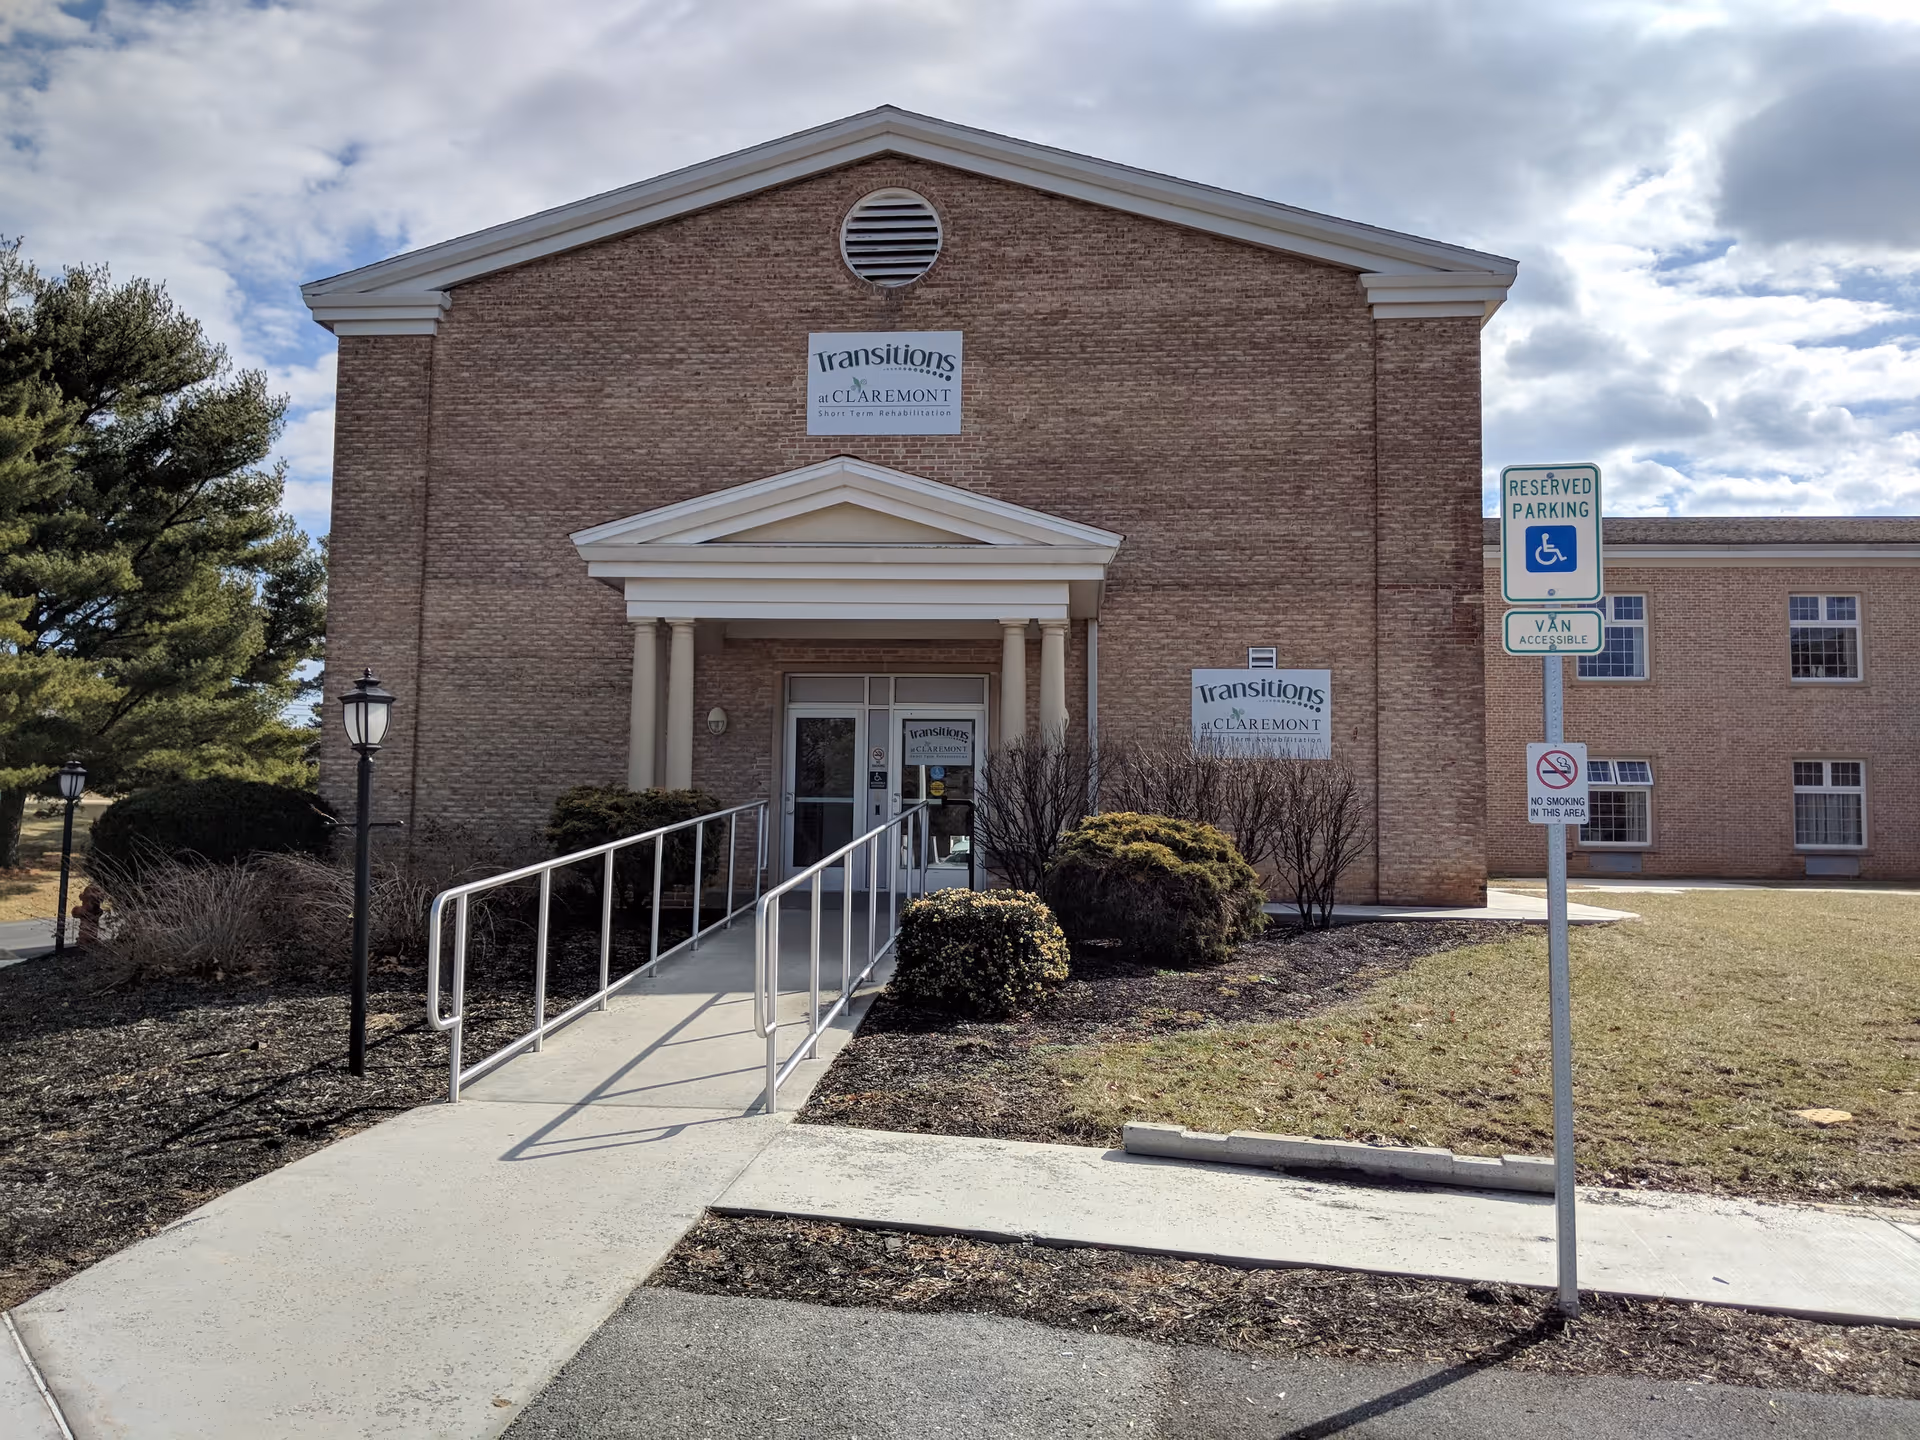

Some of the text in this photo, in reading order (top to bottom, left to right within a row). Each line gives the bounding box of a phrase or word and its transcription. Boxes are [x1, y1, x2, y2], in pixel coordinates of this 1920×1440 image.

[813, 343, 956, 373] Transitions
[818, 389, 952, 403] at CLAREMONT
[879, 409, 951, 417] Rehabilitation
[1509, 478, 1592, 496] RESERVED
[1512, 501, 1589, 519] PARKING
[1535, 620, 1571, 632] VAN
[1519, 635, 1588, 644] ACCESSIBLE
[1195, 679, 1325, 705] Transitions
[1201, 718, 1321, 730] at CLAREMONT
[909, 727, 969, 740] Transitions
[1531, 797, 1585, 806] NO SMOKING
[1542, 809, 1560, 817] THIS
[1564, 809, 1585, 817] AREA
